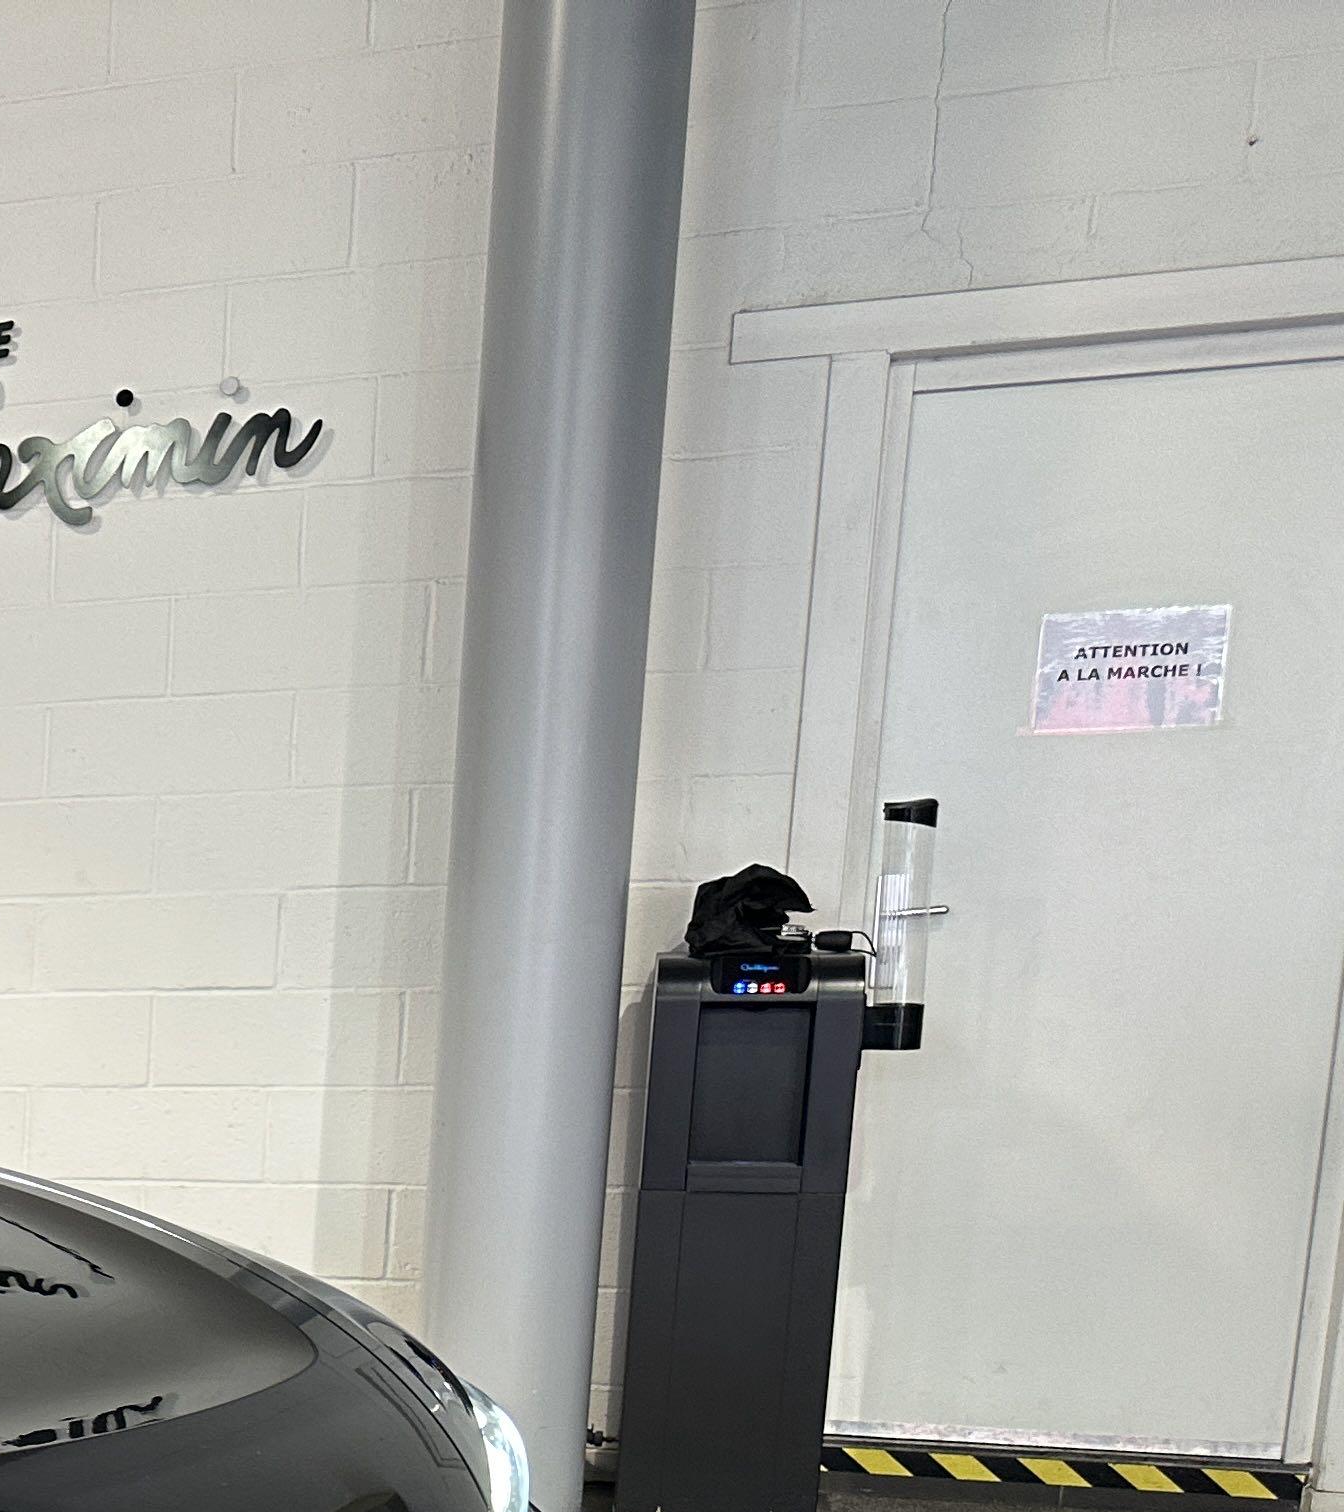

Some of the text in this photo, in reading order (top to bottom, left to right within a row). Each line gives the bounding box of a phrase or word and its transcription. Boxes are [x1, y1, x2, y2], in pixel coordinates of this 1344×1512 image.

[1074, 642, 1190, 660] ATTENTION
[1056, 663, 1203, 682] A LA MARCHE !
